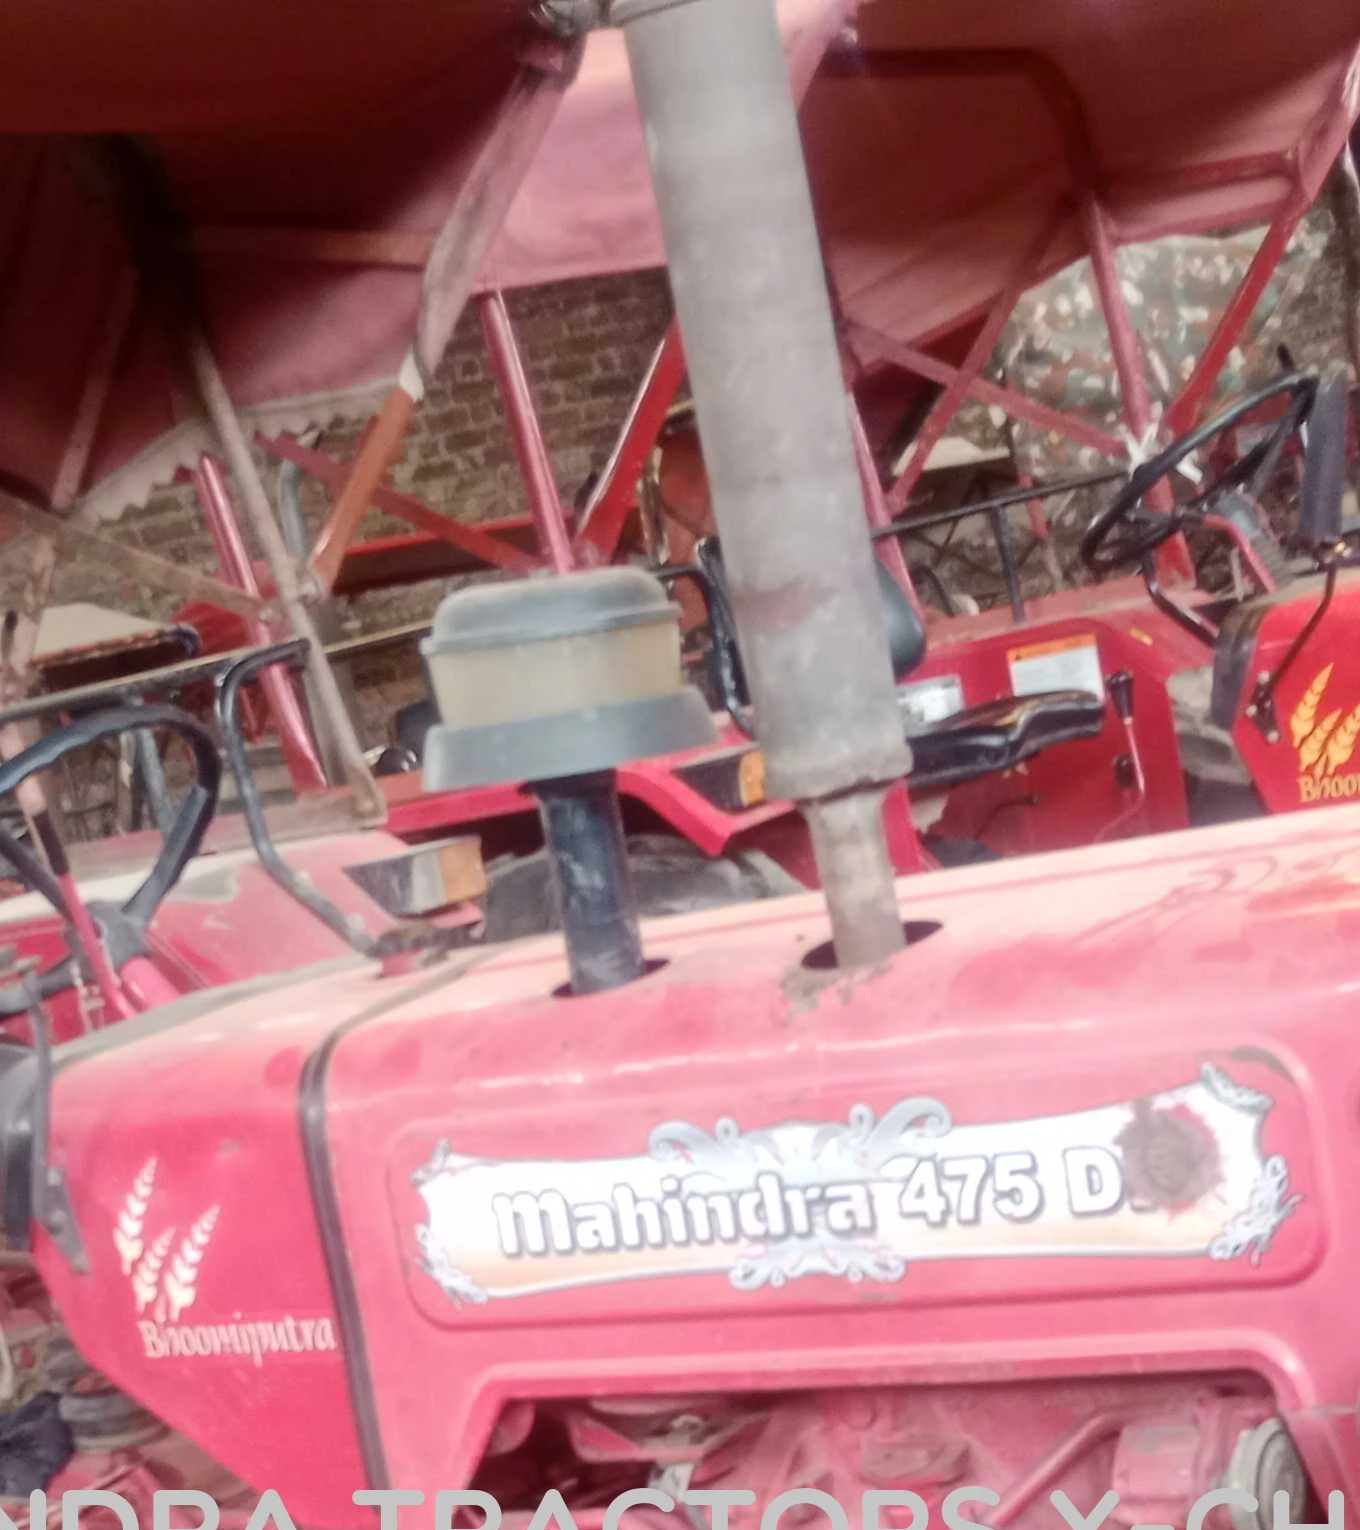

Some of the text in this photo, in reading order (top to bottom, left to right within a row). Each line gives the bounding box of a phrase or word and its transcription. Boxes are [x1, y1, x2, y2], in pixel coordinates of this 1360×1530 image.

[492, 1170, 878, 1260] Mahindra
[897, 1149, 1045, 1229] 475
[137, 1311, 337, 1368] Bhoomiputra
